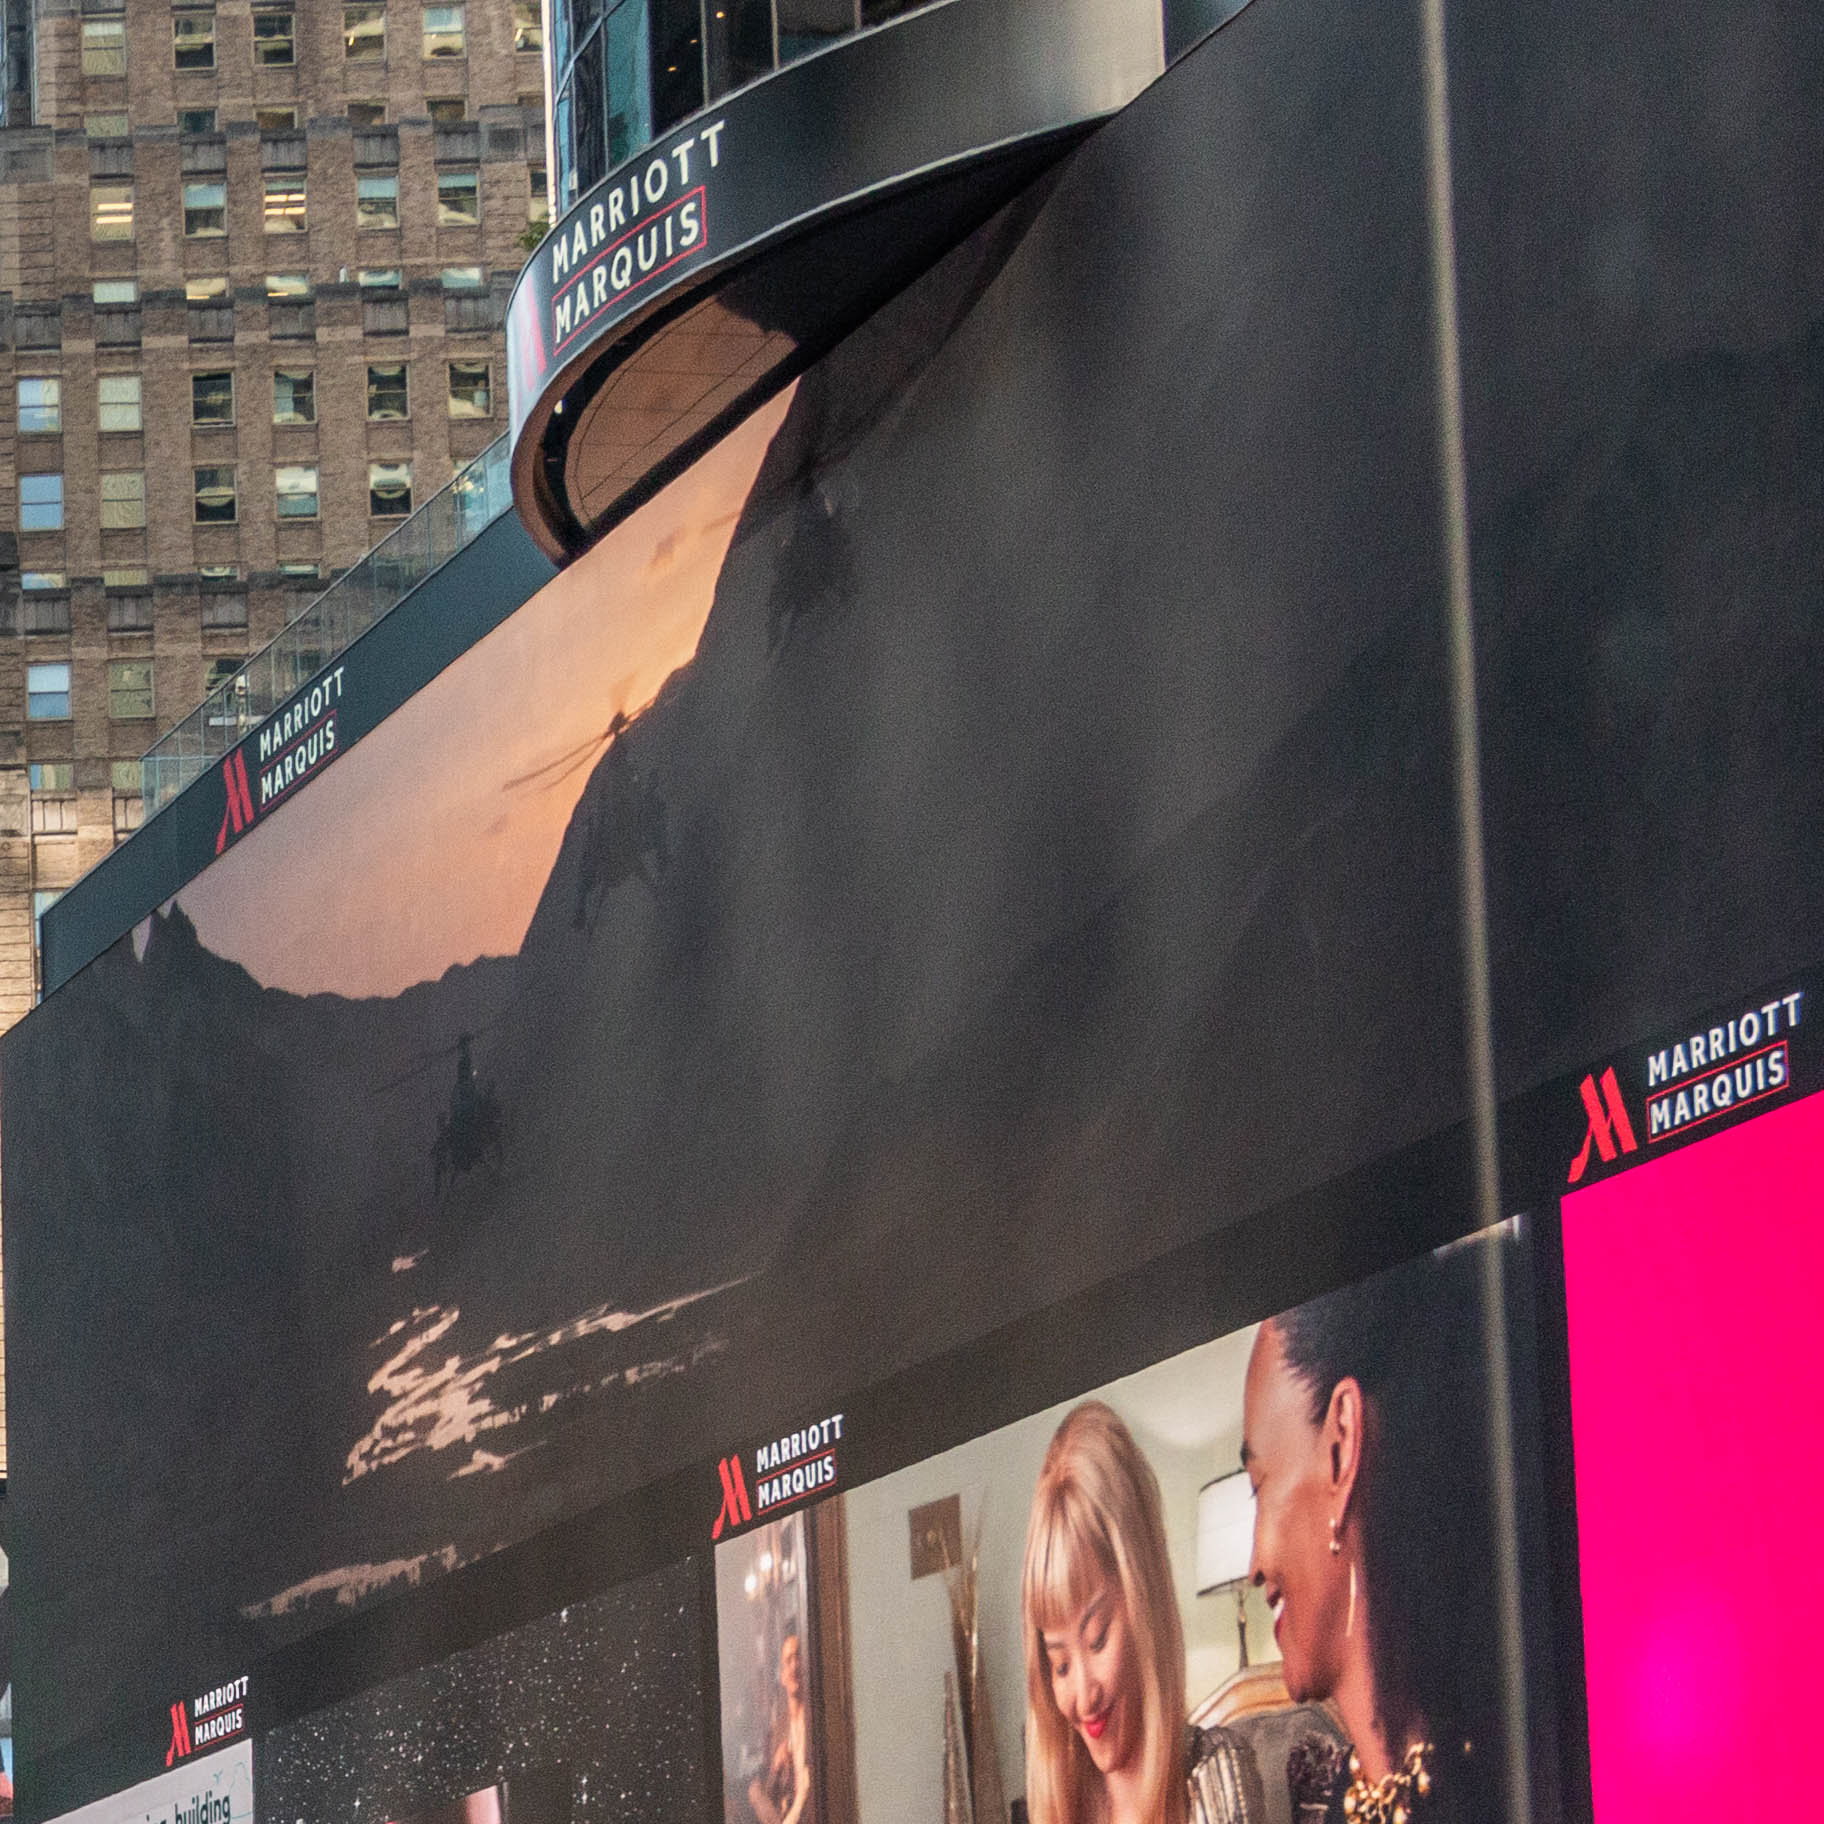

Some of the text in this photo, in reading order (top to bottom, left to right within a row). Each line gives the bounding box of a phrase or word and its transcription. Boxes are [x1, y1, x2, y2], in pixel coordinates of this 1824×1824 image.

[552, 119, 726, 285] MARRIOTT
[554, 201, 700, 346] MARQUIS
[257, 665, 346, 763] MARRIOTT
[260, 716, 337, 804] MARQUIS
[1647, 990, 1803, 1087] MARRIOTT
[1649, 1049, 1786, 1135] MARQUIS
[756, 1413, 844, 1473] MARRIOTT
[757, 1457, 837, 1510] MARQUIS
[194, 1675, 249, 1718] MARRIOTT
[194, 1705, 243, 1746] MARQUIS
